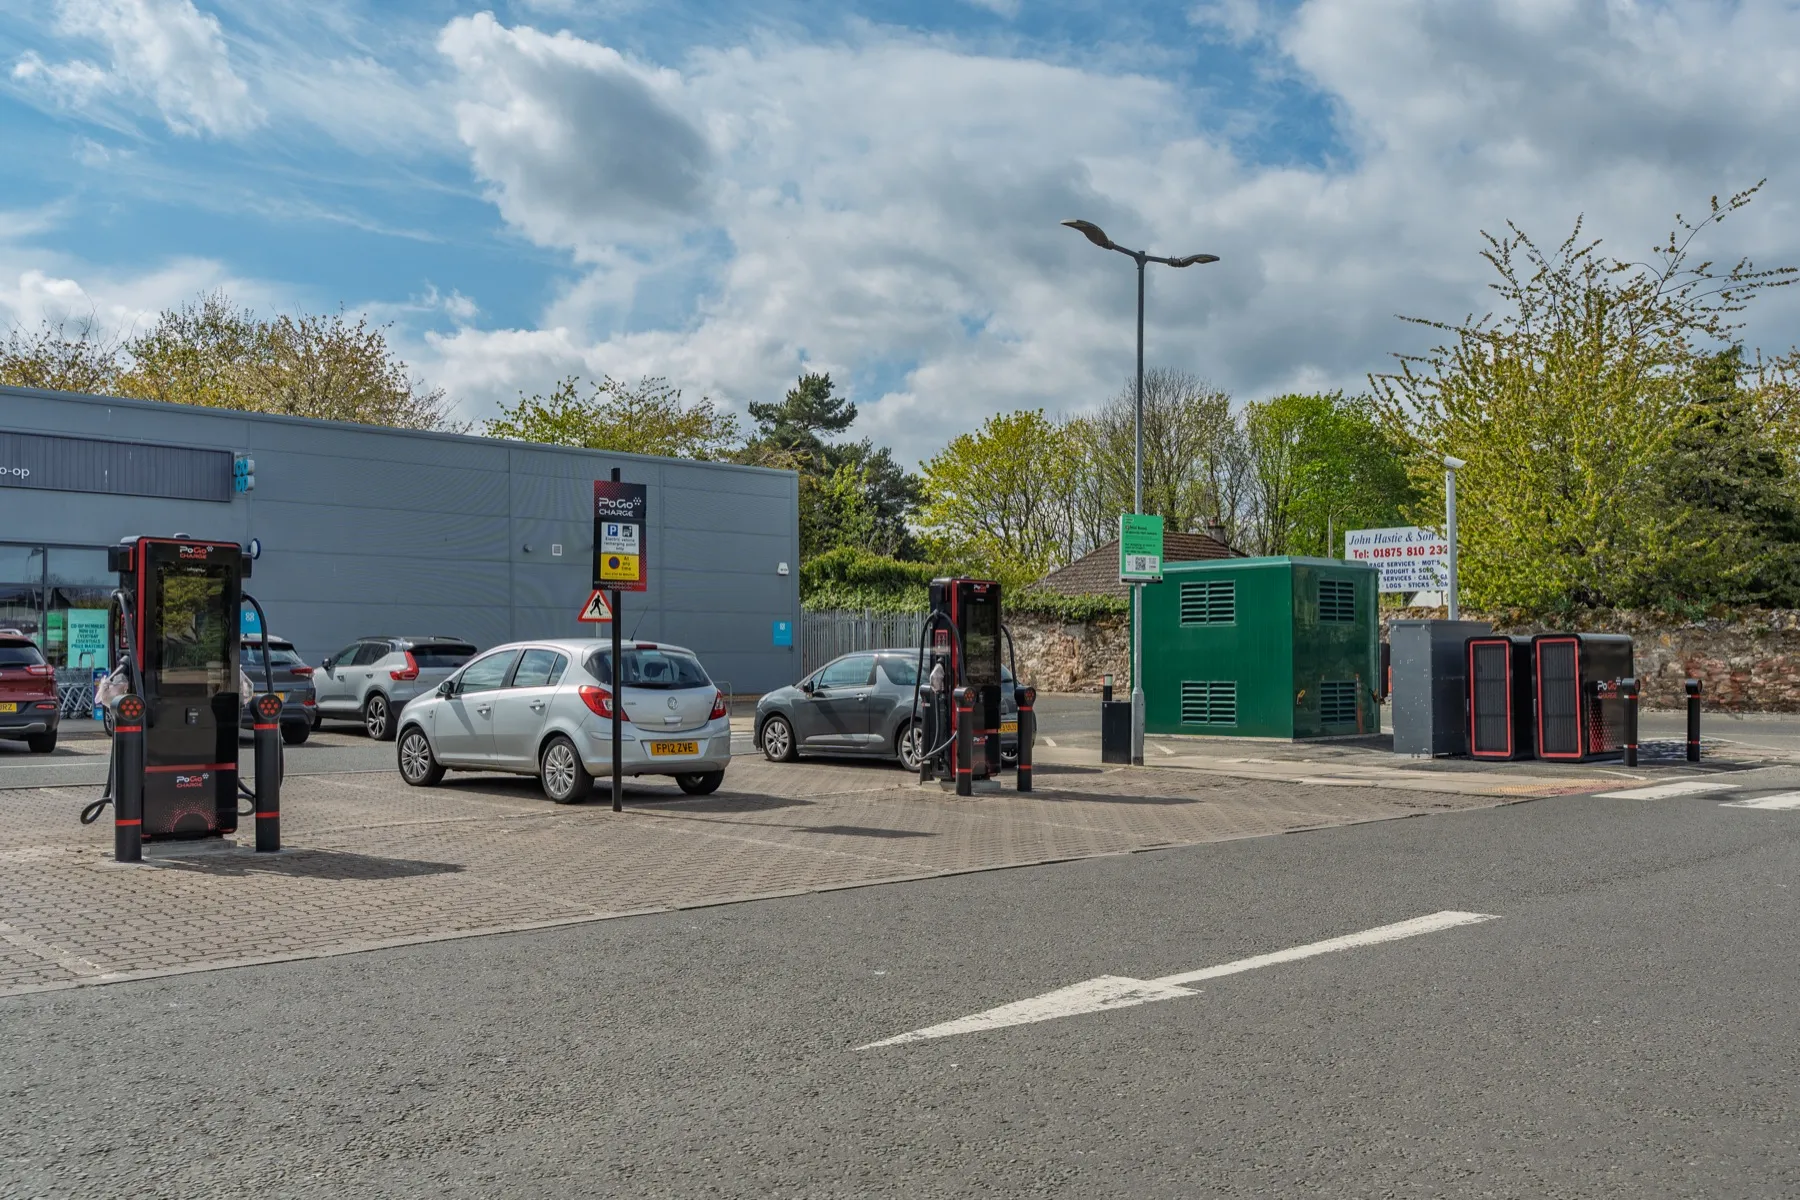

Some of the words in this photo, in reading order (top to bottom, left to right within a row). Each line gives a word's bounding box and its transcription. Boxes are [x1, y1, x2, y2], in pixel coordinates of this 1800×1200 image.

[0, 467, 30, 479] o-op
[599, 497, 634, 509] PoGo
[599, 509, 634, 517] CHARGE
[1349, 534, 1371, 546] John
[1374, 532, 1402, 544] Hastie
[1405, 531, 1413, 542] &
[180, 545, 207, 554] PoGo
[1353, 549, 1369, 559] Tel:
[1373, 547, 1402, 558] 01875
[1406, 546, 1425, 557] 810
[1597, 680, 1617, 690] PoGo
[656, 743, 675, 753] FP12
[677, 742, 694, 752] ZVE
[177, 775, 203, 783] PoGo
